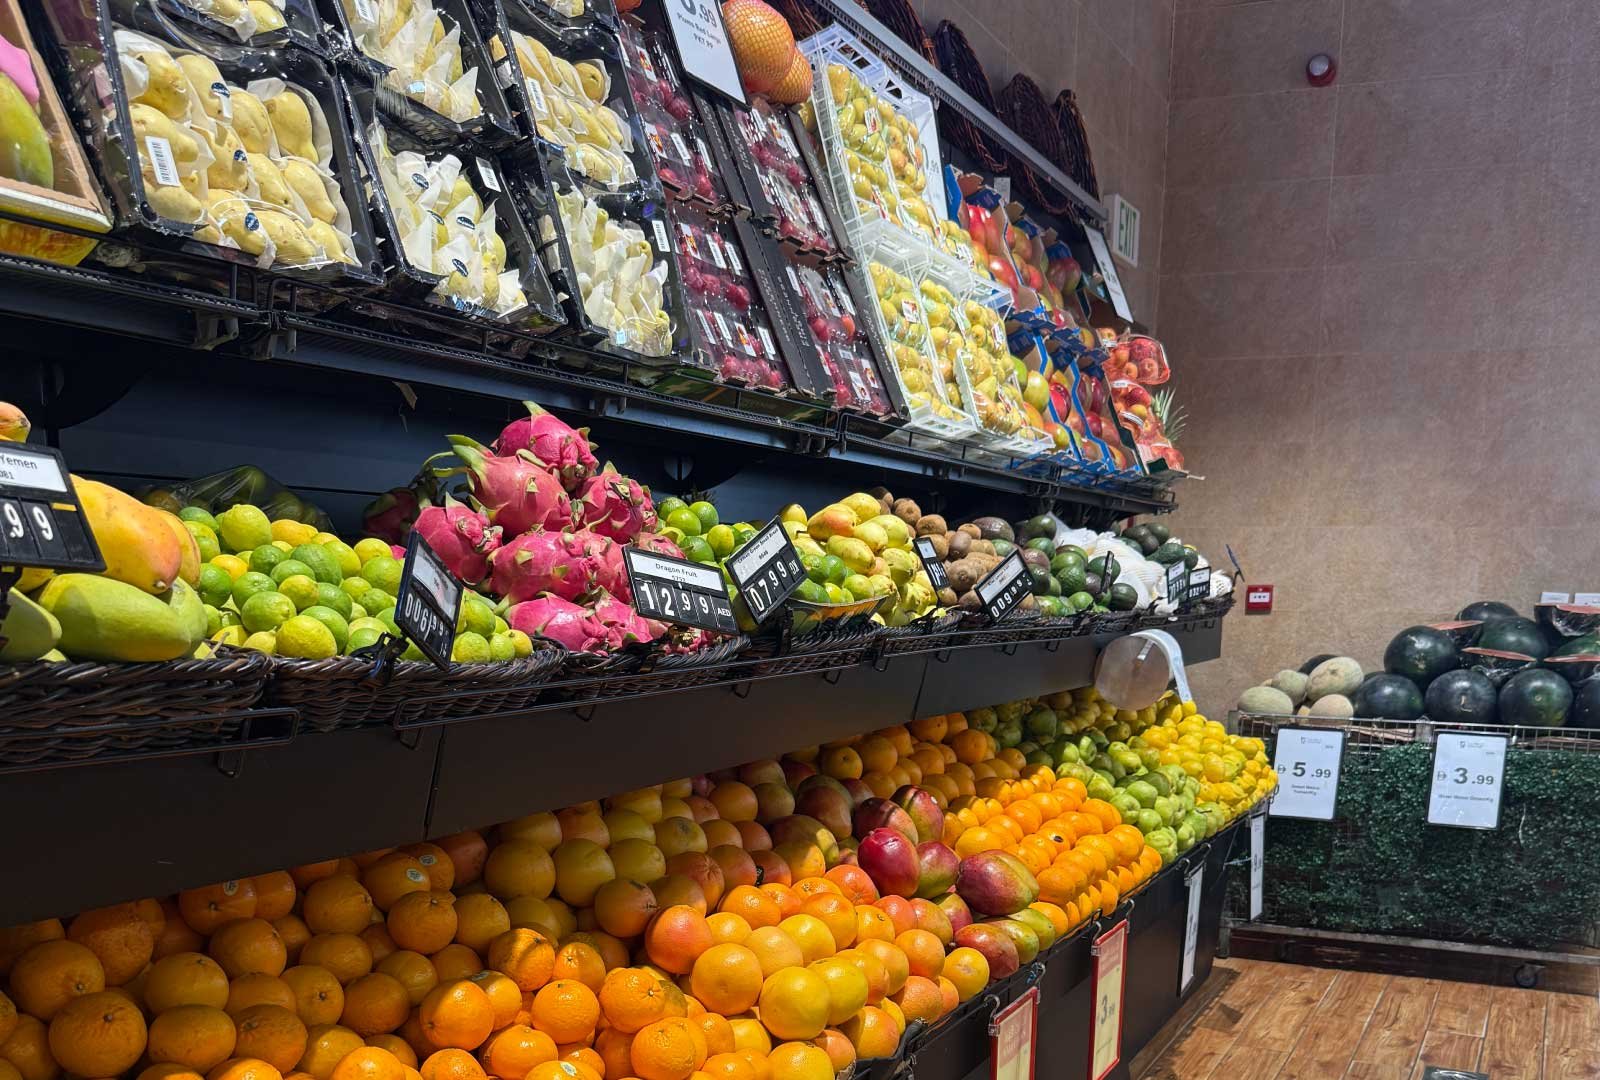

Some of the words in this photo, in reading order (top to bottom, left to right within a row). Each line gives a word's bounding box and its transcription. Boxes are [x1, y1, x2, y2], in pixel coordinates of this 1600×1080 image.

[1119, 201, 1137, 260] EXIT
[0, 454, 38, 470] Yemen
[655, 563, 681, 575] Dragon
[682, 568, 699, 578] Fruit
[717, 607, 732, 616] AED
